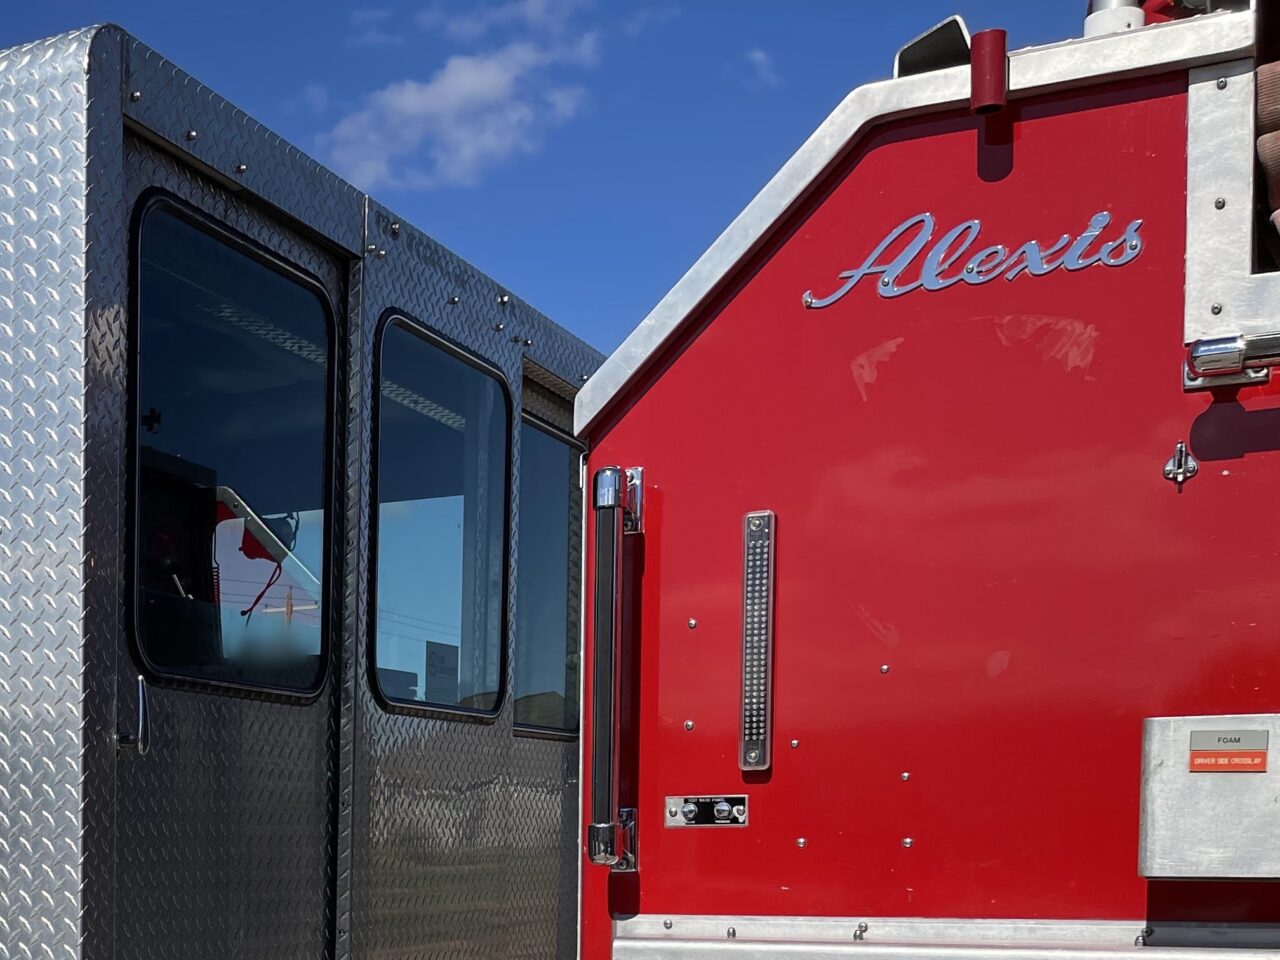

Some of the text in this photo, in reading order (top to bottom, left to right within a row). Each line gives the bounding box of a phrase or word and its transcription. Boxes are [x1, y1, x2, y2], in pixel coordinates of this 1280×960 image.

[803, 211, 1144, 309] Alexis
[1217, 736, 1241, 744] FOAM
[1194, 757, 1216, 765] DRIVER
